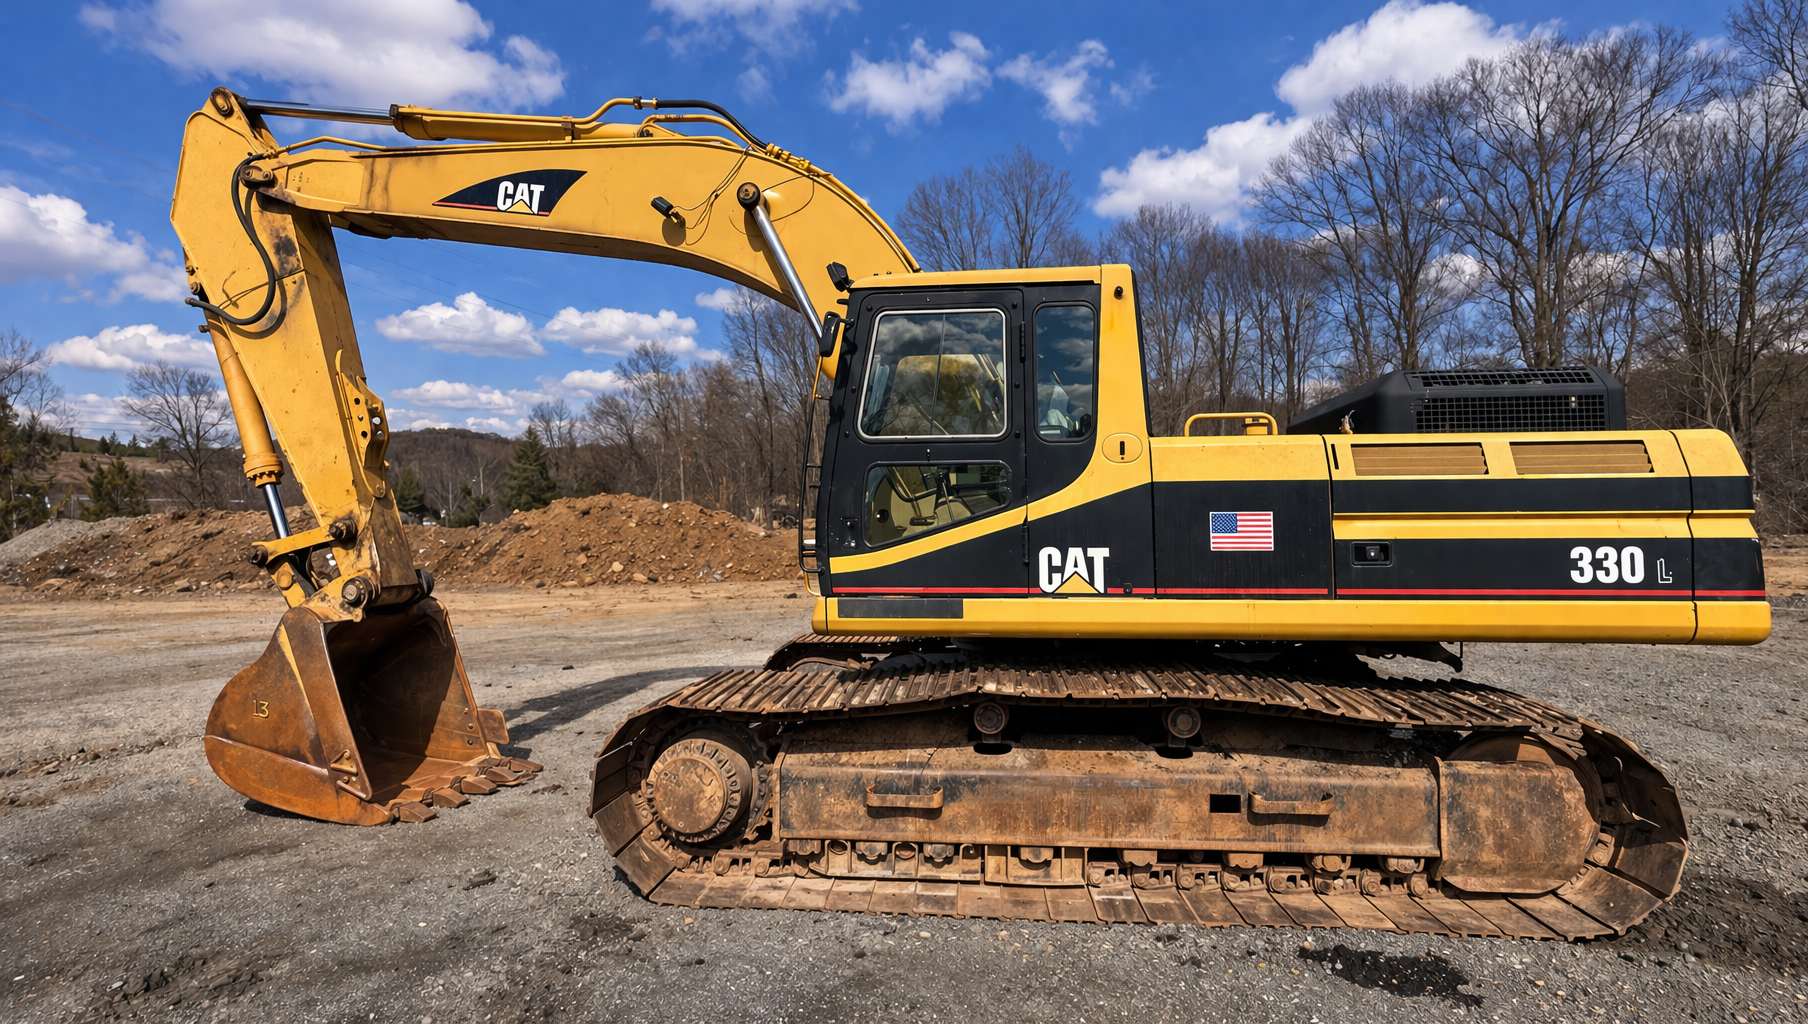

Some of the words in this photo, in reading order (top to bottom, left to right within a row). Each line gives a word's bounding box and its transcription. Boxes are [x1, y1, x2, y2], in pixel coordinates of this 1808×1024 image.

[497, 181, 545, 214] CAT
[1039, 546, 1110, 594] CAT
[1570, 546, 1645, 584] 330
[1657, 558, 1673, 584] L
